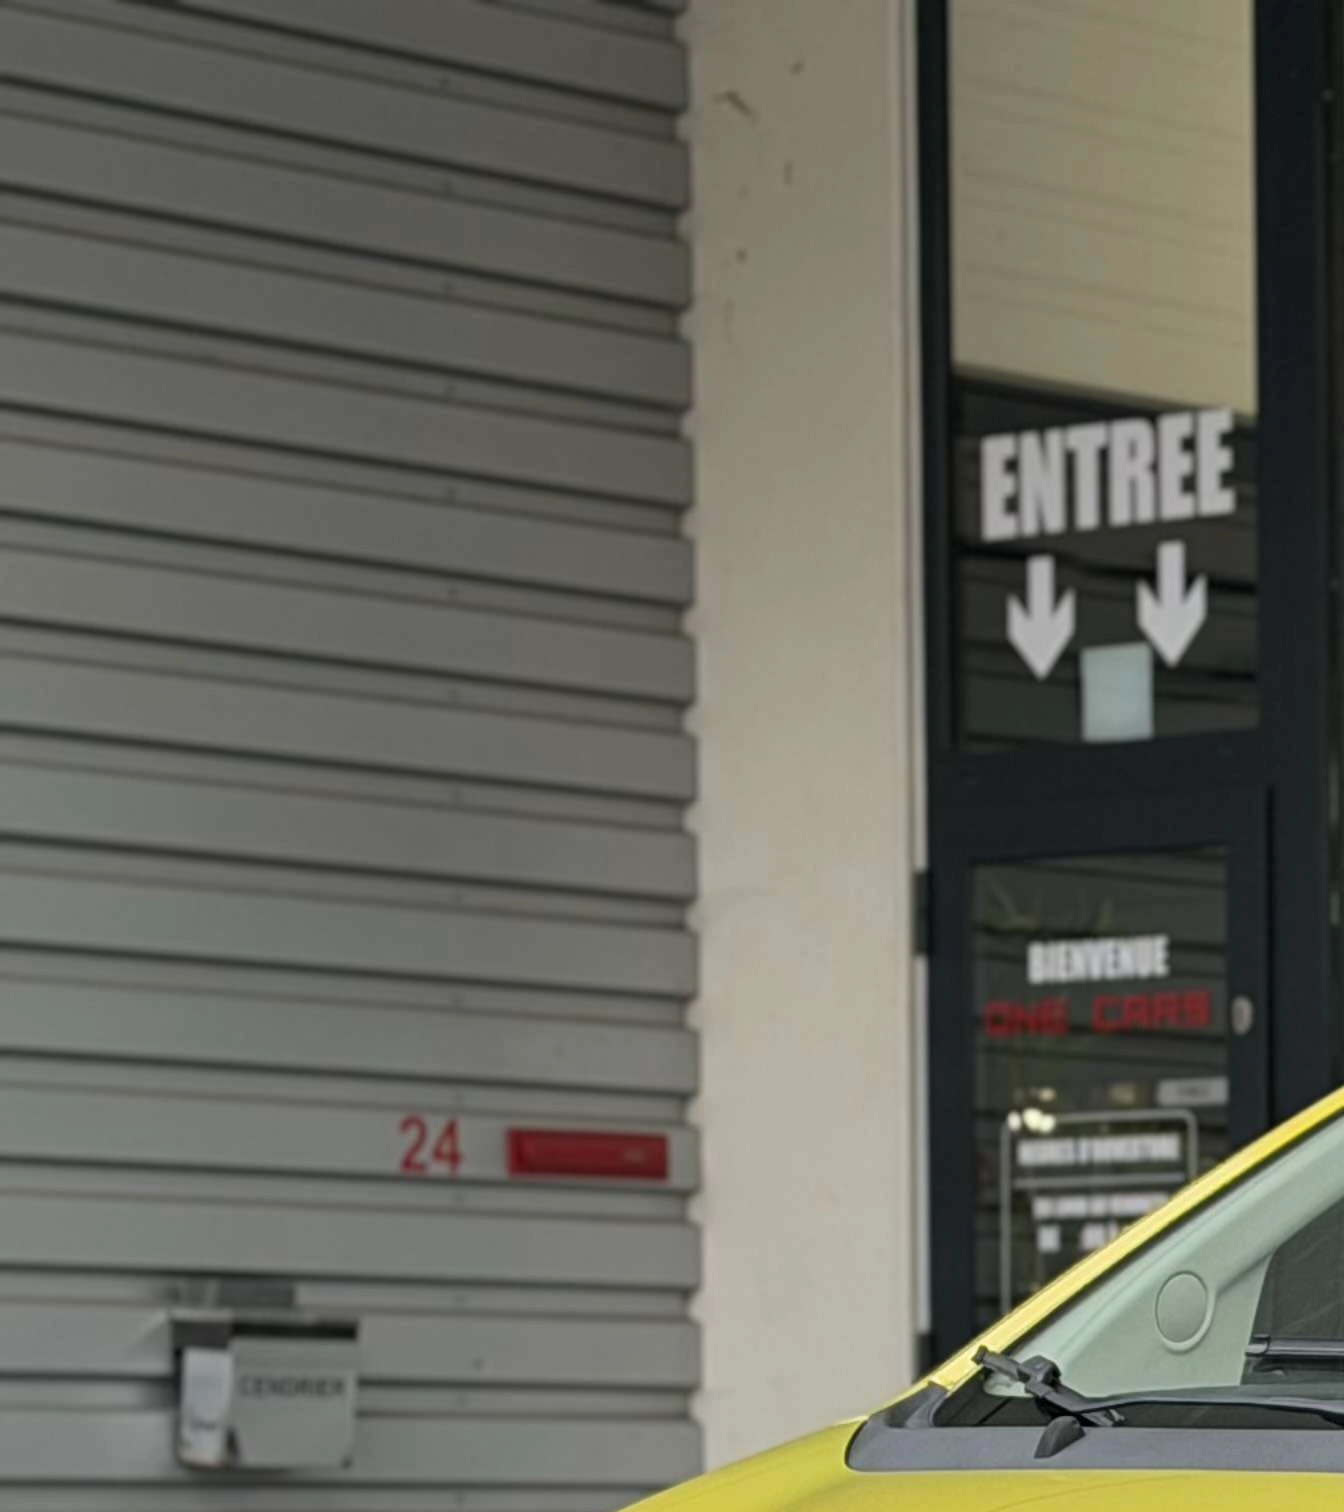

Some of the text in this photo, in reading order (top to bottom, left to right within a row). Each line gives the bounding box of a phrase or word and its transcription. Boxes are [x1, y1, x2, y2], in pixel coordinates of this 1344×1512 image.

[980, 408, 1237, 544] ENTREE
[1027, 934, 1170, 985] BIENVENUE
[1091, 991, 1212, 1032] CARS
[398, 1113, 464, 1175] 24
[238, 1374, 346, 1400] CENDRIER
